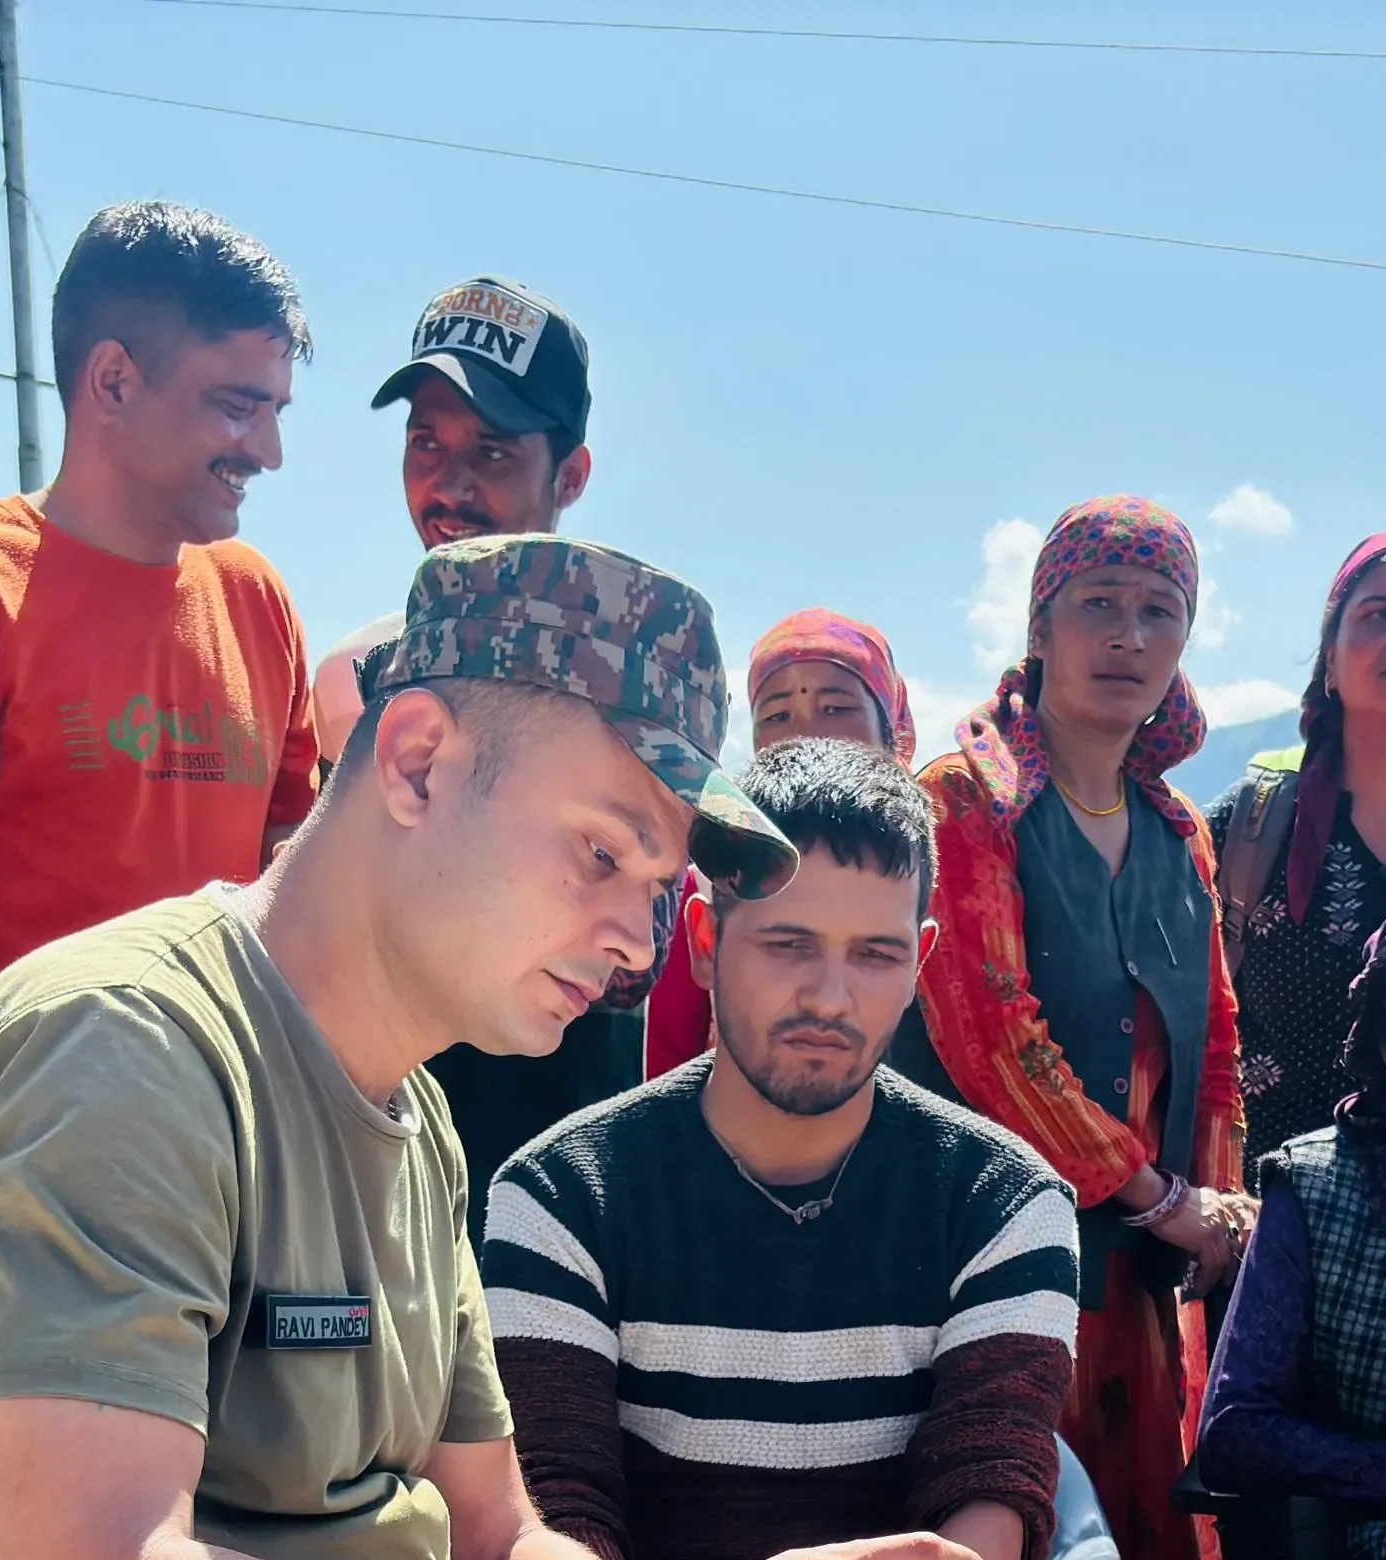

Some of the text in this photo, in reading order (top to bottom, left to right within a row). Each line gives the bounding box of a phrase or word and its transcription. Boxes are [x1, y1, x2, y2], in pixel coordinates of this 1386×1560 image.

[423, 316, 526, 364] WIN
[277, 1316, 367, 1337] RAVI PANDEY
